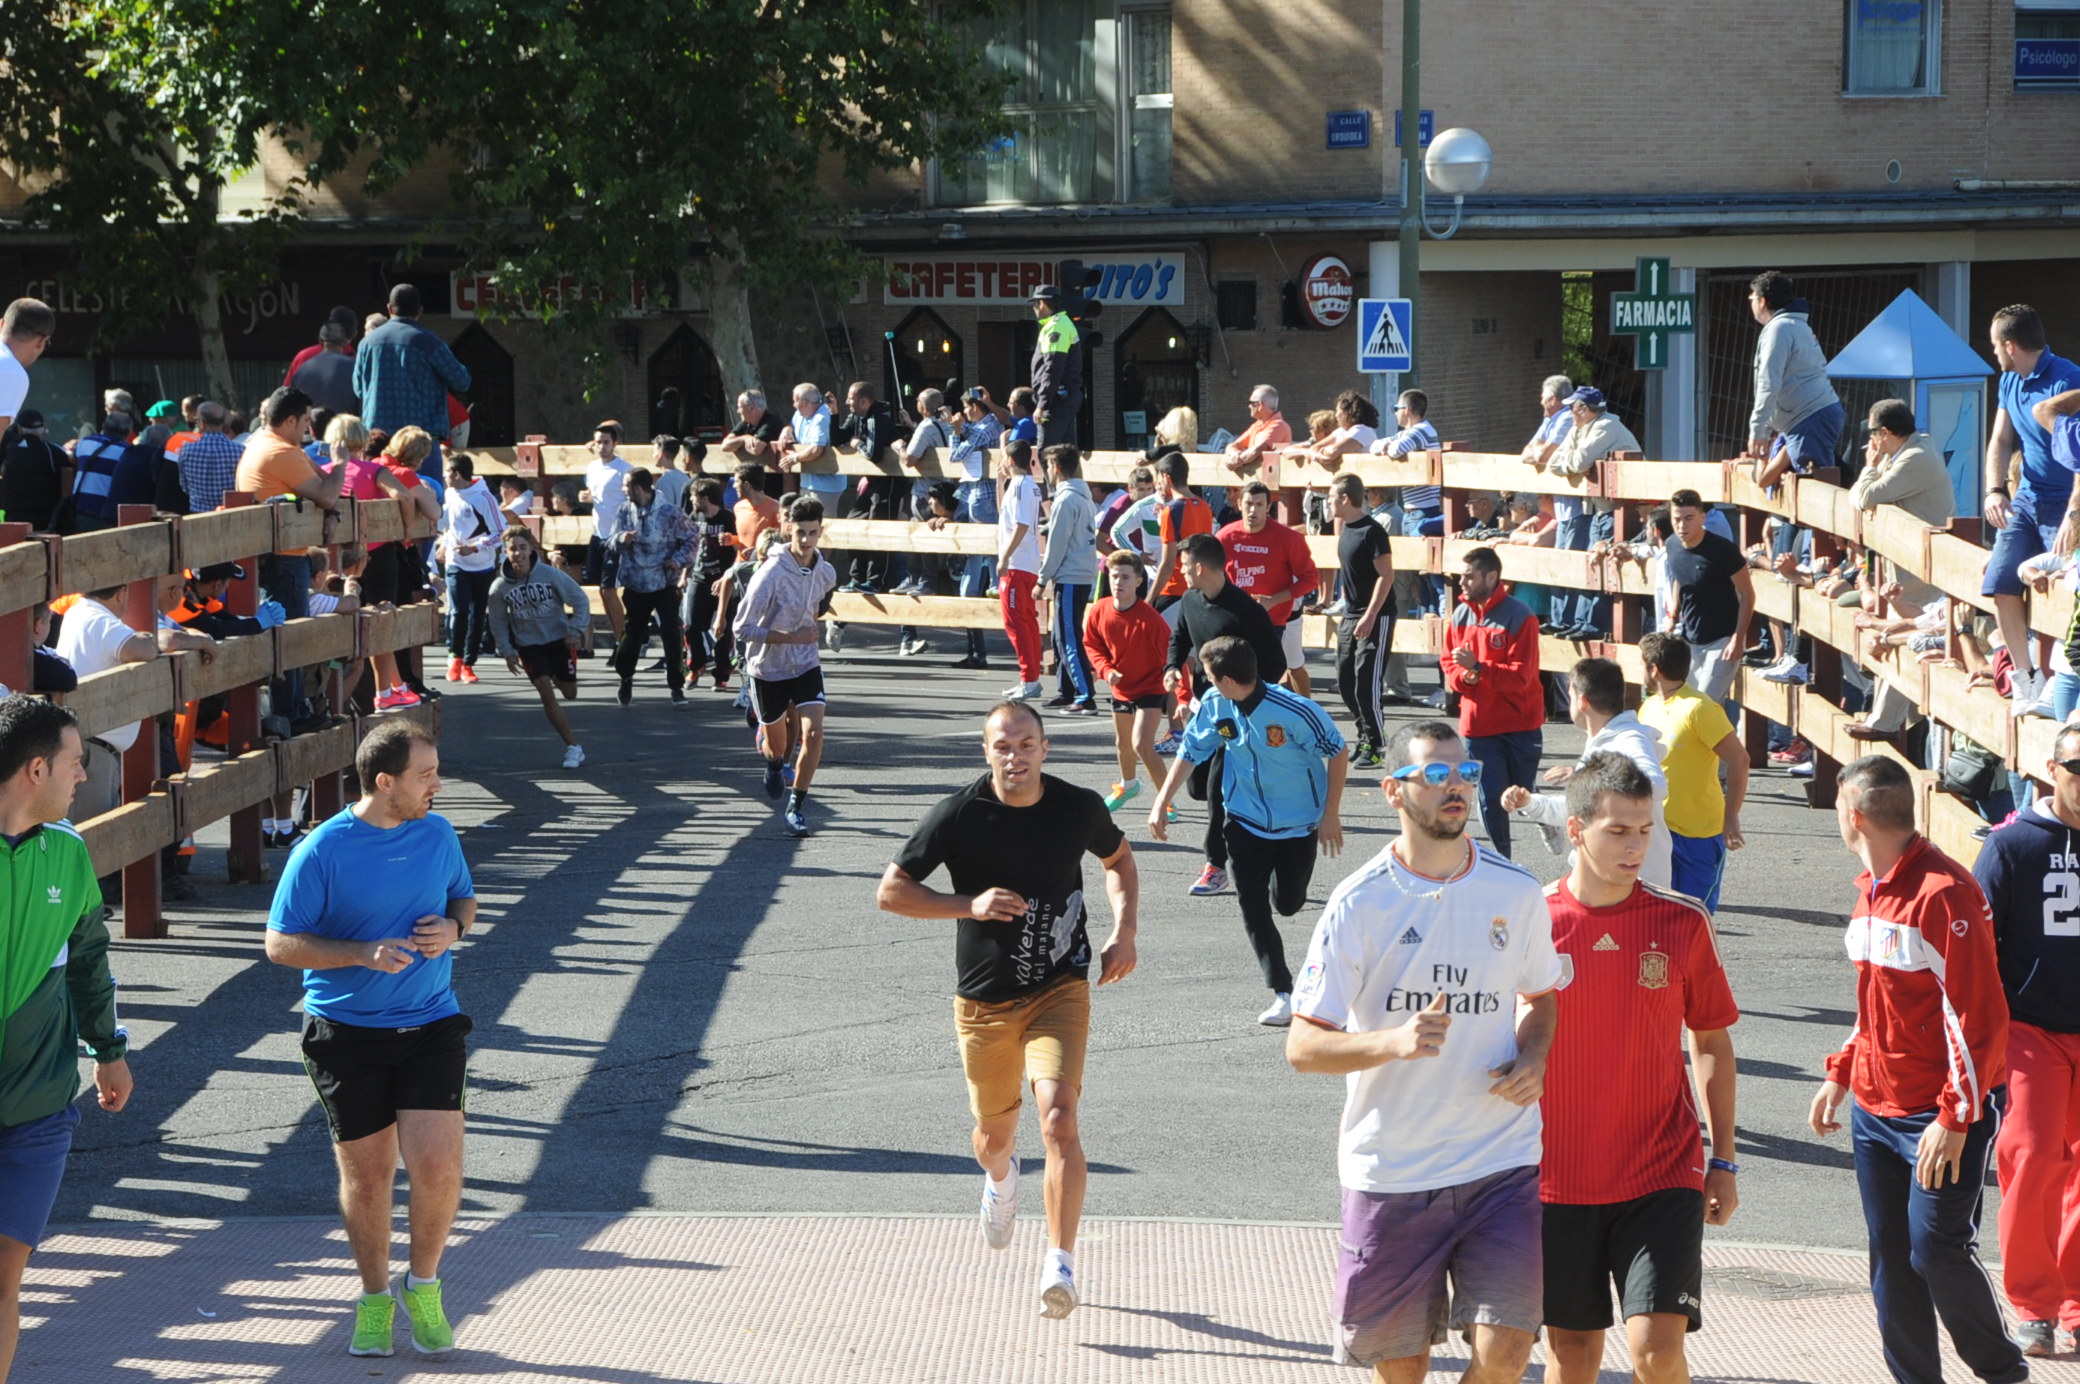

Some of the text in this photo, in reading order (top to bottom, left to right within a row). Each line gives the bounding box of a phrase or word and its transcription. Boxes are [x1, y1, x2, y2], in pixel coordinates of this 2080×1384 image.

[2019, 47, 2077, 69] Psicólogo
[1340, 116, 1362, 125] CALLE
[889, 262, 1061, 298] CAFETERI
[1615, 300, 1692, 327] FARMACIA
[1432, 963, 1469, 988] Fly
[1385, 985, 1500, 1016] Emrates
